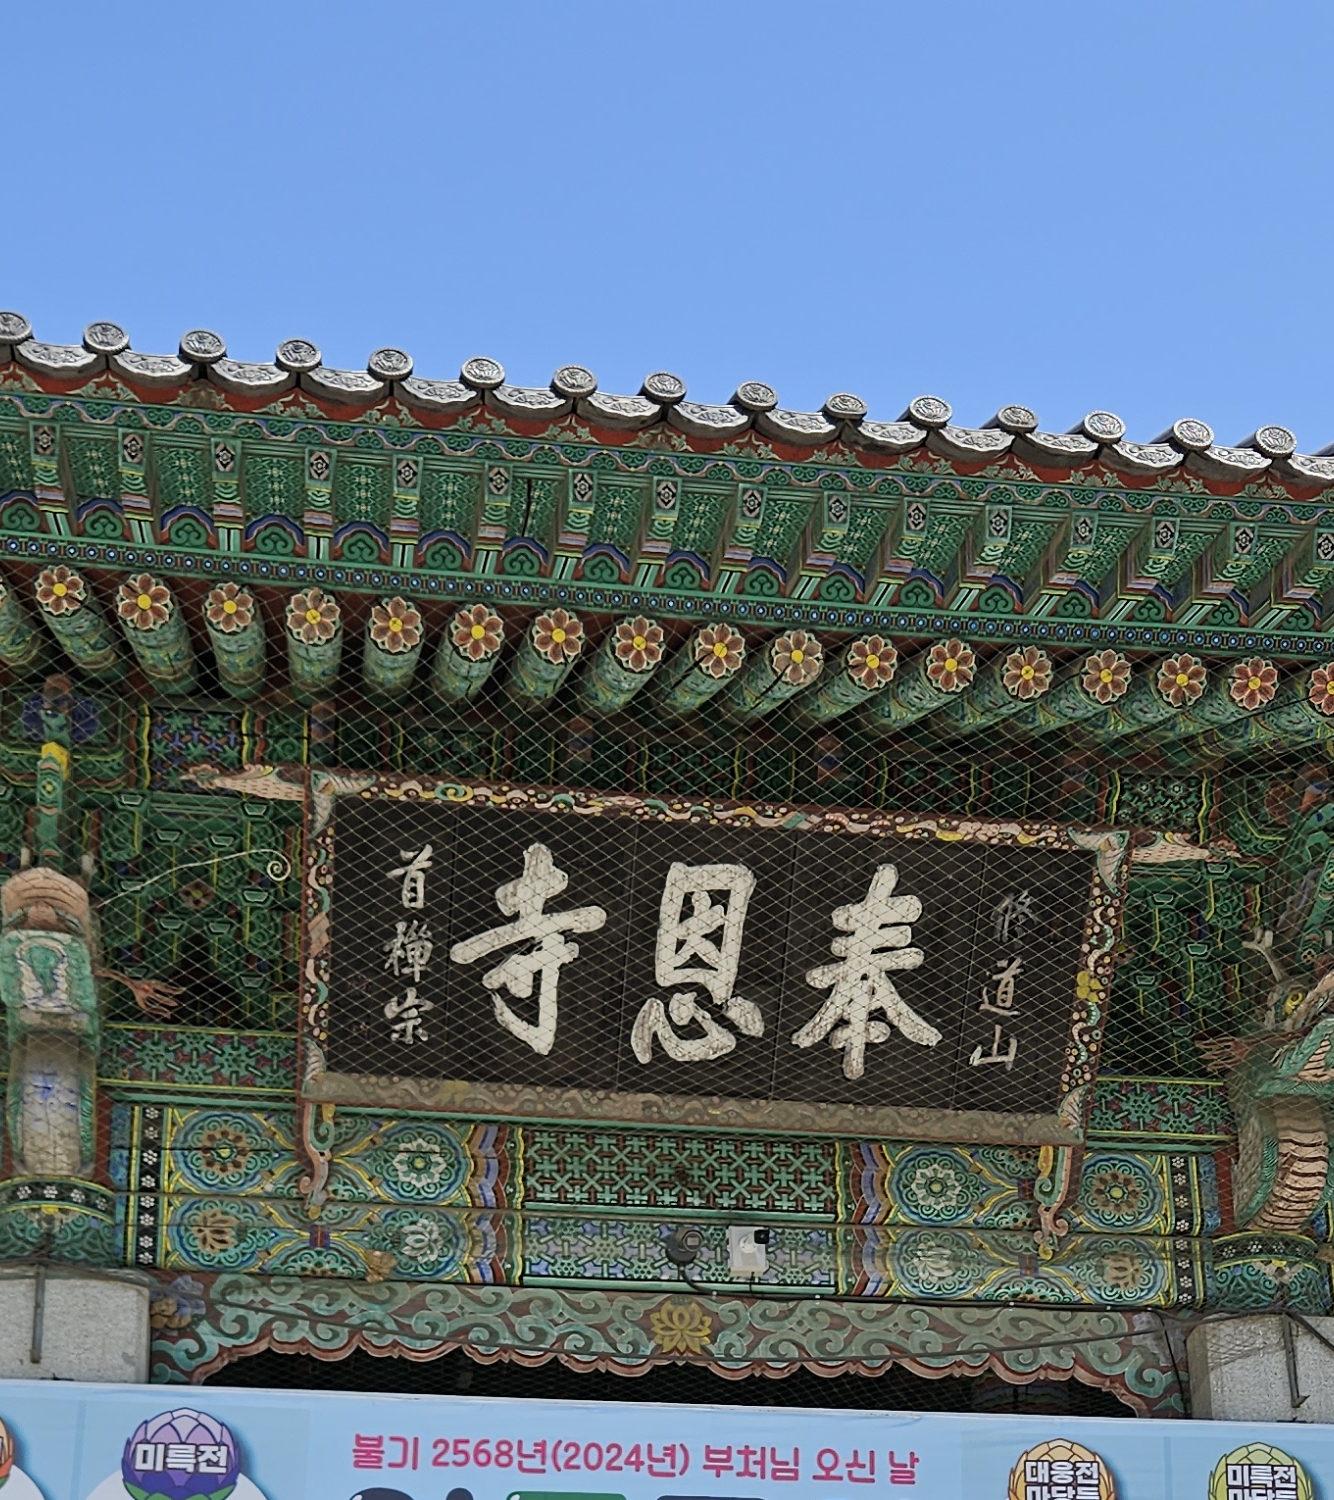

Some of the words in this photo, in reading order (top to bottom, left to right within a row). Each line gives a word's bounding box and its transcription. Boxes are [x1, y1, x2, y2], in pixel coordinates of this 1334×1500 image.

[134, 1442, 228, 1475] 미륵전
[352, 1433, 419, 1470] 불기
[432, 1438, 690, 1478] 2568년(2024년)
[703, 1444, 800, 1481] 부처님
[813, 1448, 876, 1484] 오신
[889, 1451, 920, 1485] 날
[1024, 1460, 1100, 1485] 대웅전
[1227, 1464, 1296, 1489] 미륵전
